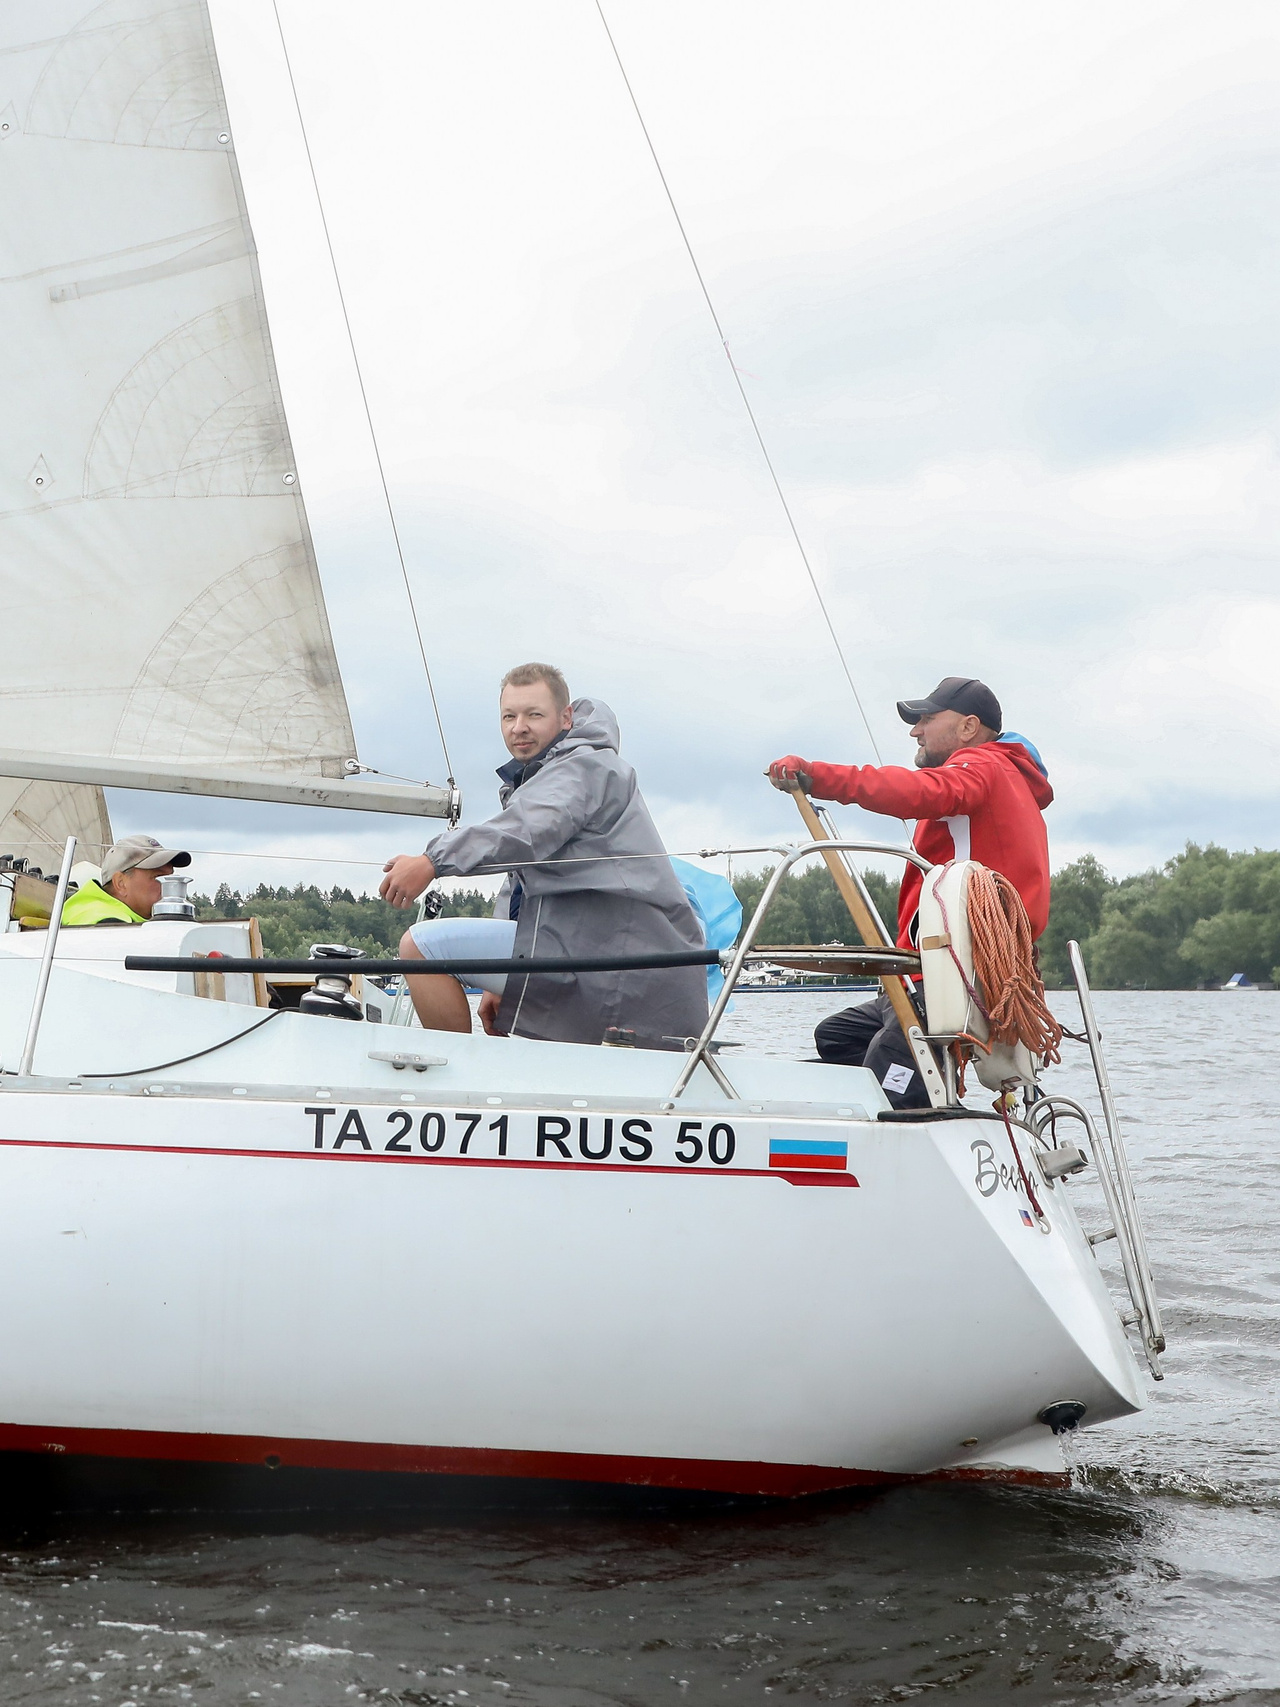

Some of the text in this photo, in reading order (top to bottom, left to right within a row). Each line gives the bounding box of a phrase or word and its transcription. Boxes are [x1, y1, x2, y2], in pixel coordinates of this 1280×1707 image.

[305, 1107, 736, 1165] TA 2071 RUS 50
